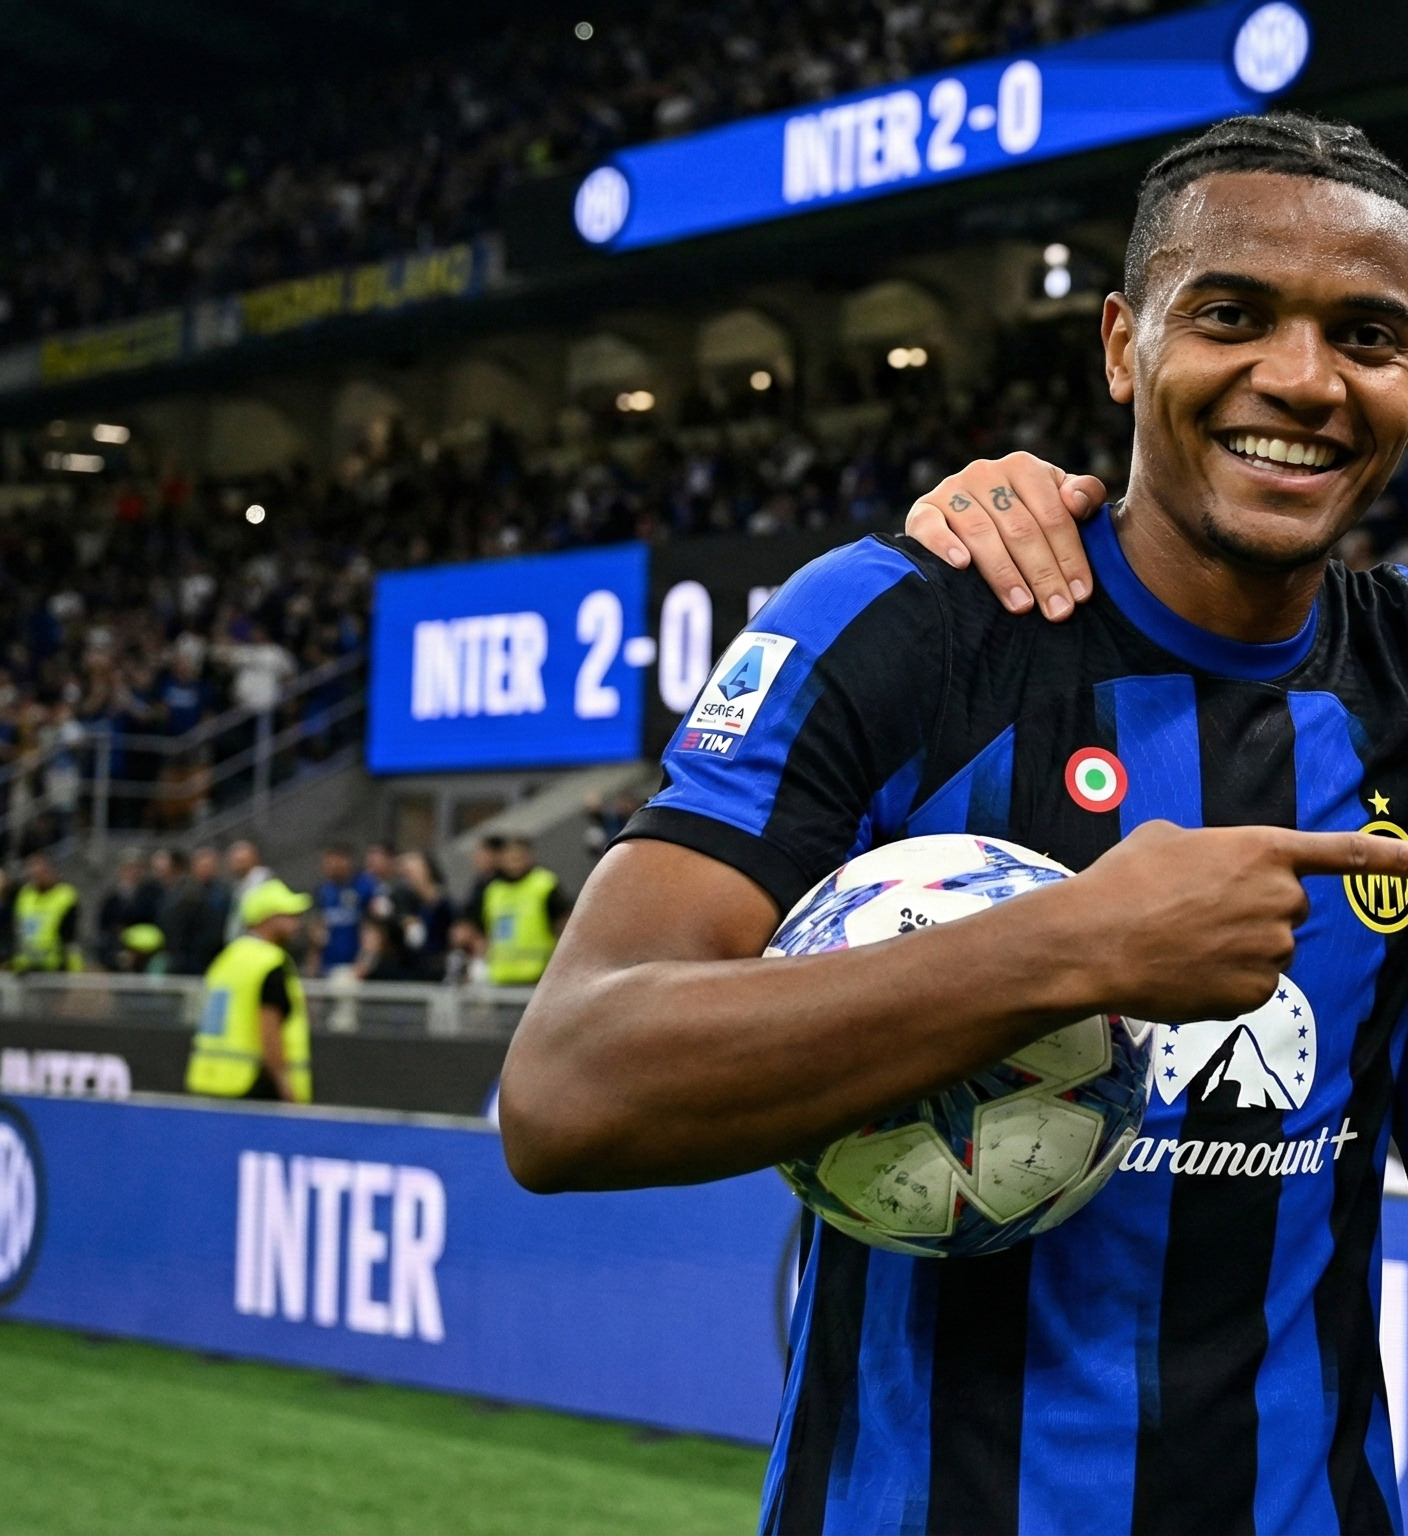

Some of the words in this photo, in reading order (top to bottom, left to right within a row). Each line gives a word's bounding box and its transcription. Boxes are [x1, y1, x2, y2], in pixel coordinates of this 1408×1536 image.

[783, 89, 922, 204] INTER
[411, 611, 548, 721] INTER
[697, 732, 734, 754] TIM
[735, 708, 745, 720] A
[1118, 1117, 1358, 1177] aramount+
[235, 1149, 446, 1343] INTER
